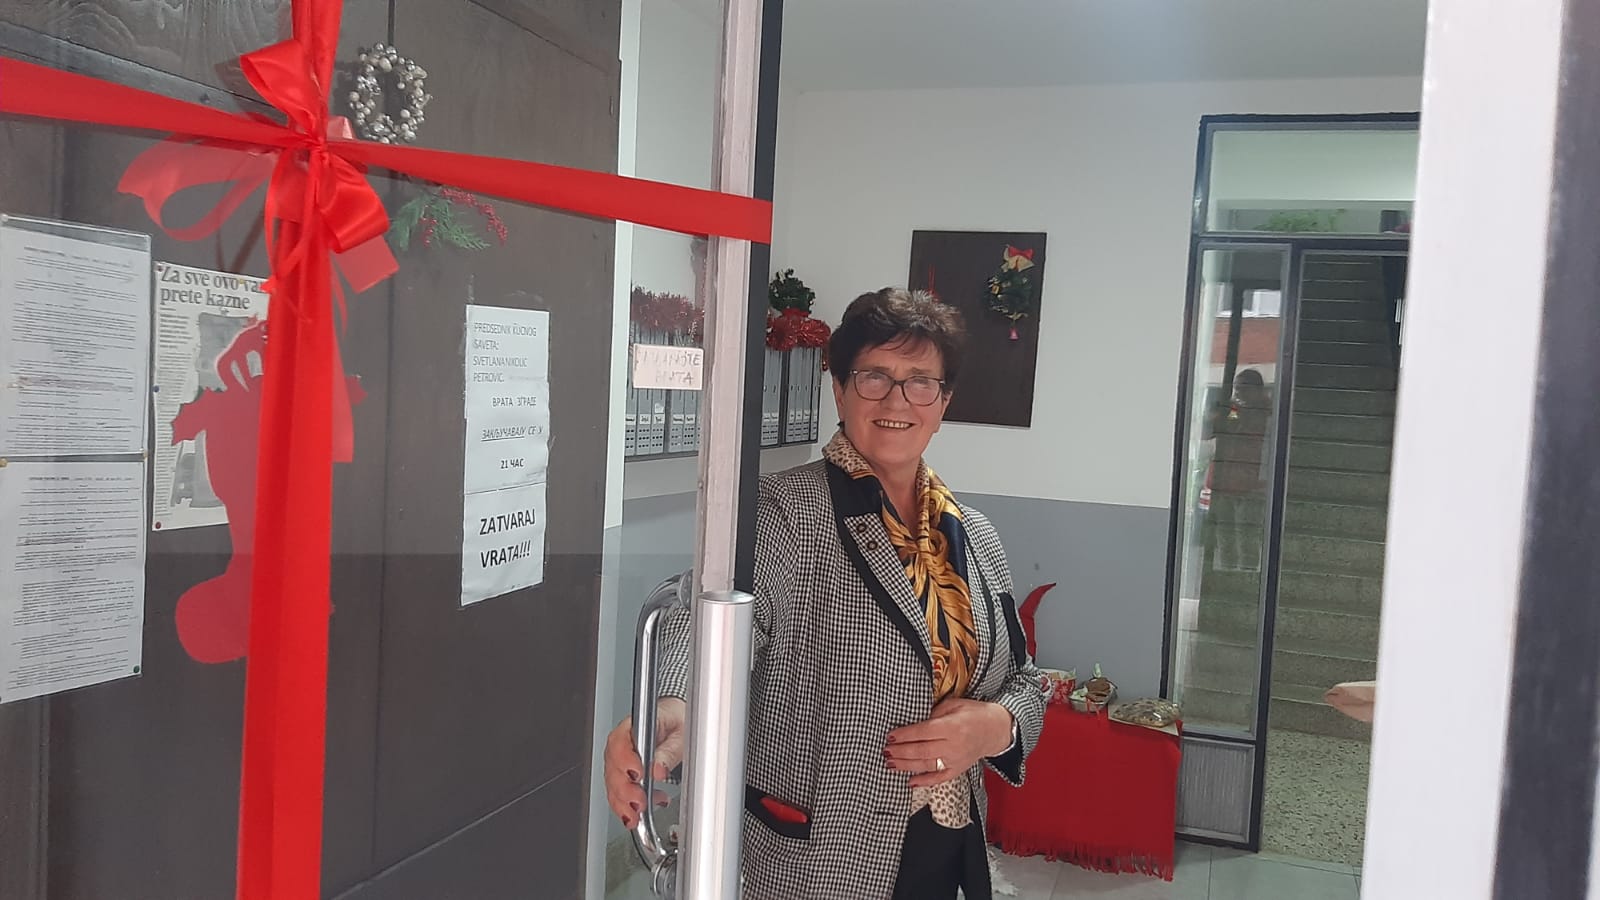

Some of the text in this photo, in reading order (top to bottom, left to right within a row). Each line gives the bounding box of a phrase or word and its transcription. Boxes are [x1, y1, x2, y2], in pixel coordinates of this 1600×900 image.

[161, 266, 260, 294] Za sve ovo va
[160, 288, 251, 310] prete kazne
[500, 460, 508, 469] 21
[480, 508, 536, 535] ZATVARAJ
[480, 540, 531, 568] VRATA!!!
